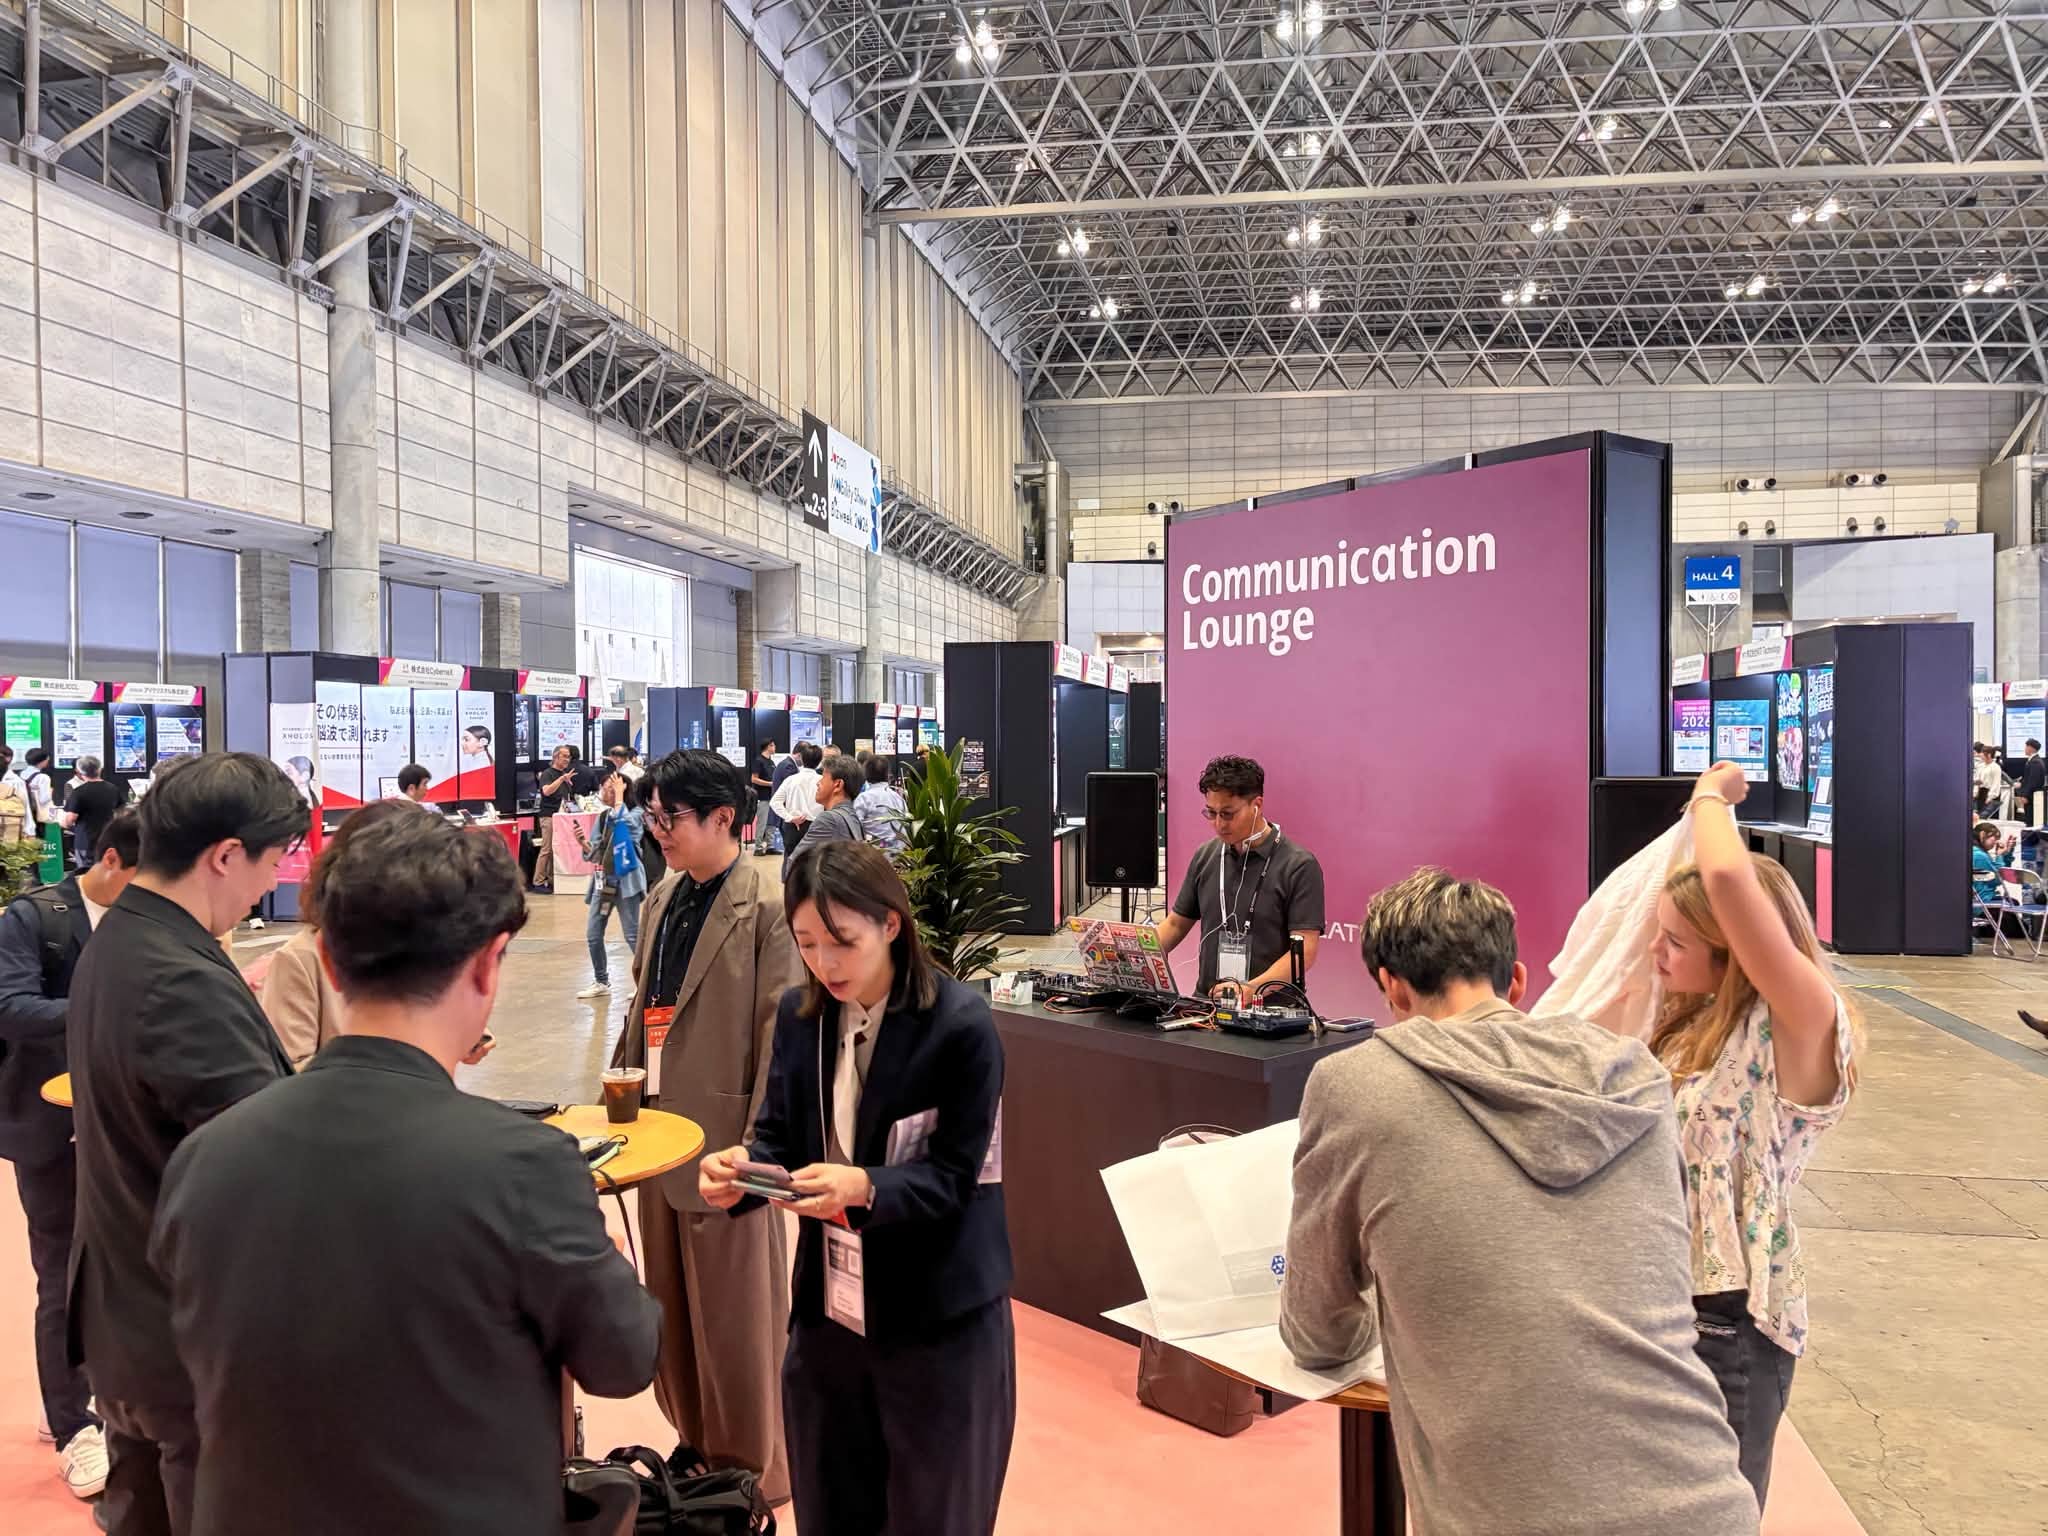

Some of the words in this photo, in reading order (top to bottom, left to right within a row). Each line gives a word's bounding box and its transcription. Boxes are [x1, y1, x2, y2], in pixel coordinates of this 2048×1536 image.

[1182, 527, 1497, 605] Communication
[1692, 572, 1719, 581] HALL
[1721, 564, 1735, 581] 4
[1183, 606, 1314, 657] Lounge
[317, 703, 366, 721] その体験、
[317, 724, 390, 743] 脳波で測れます
